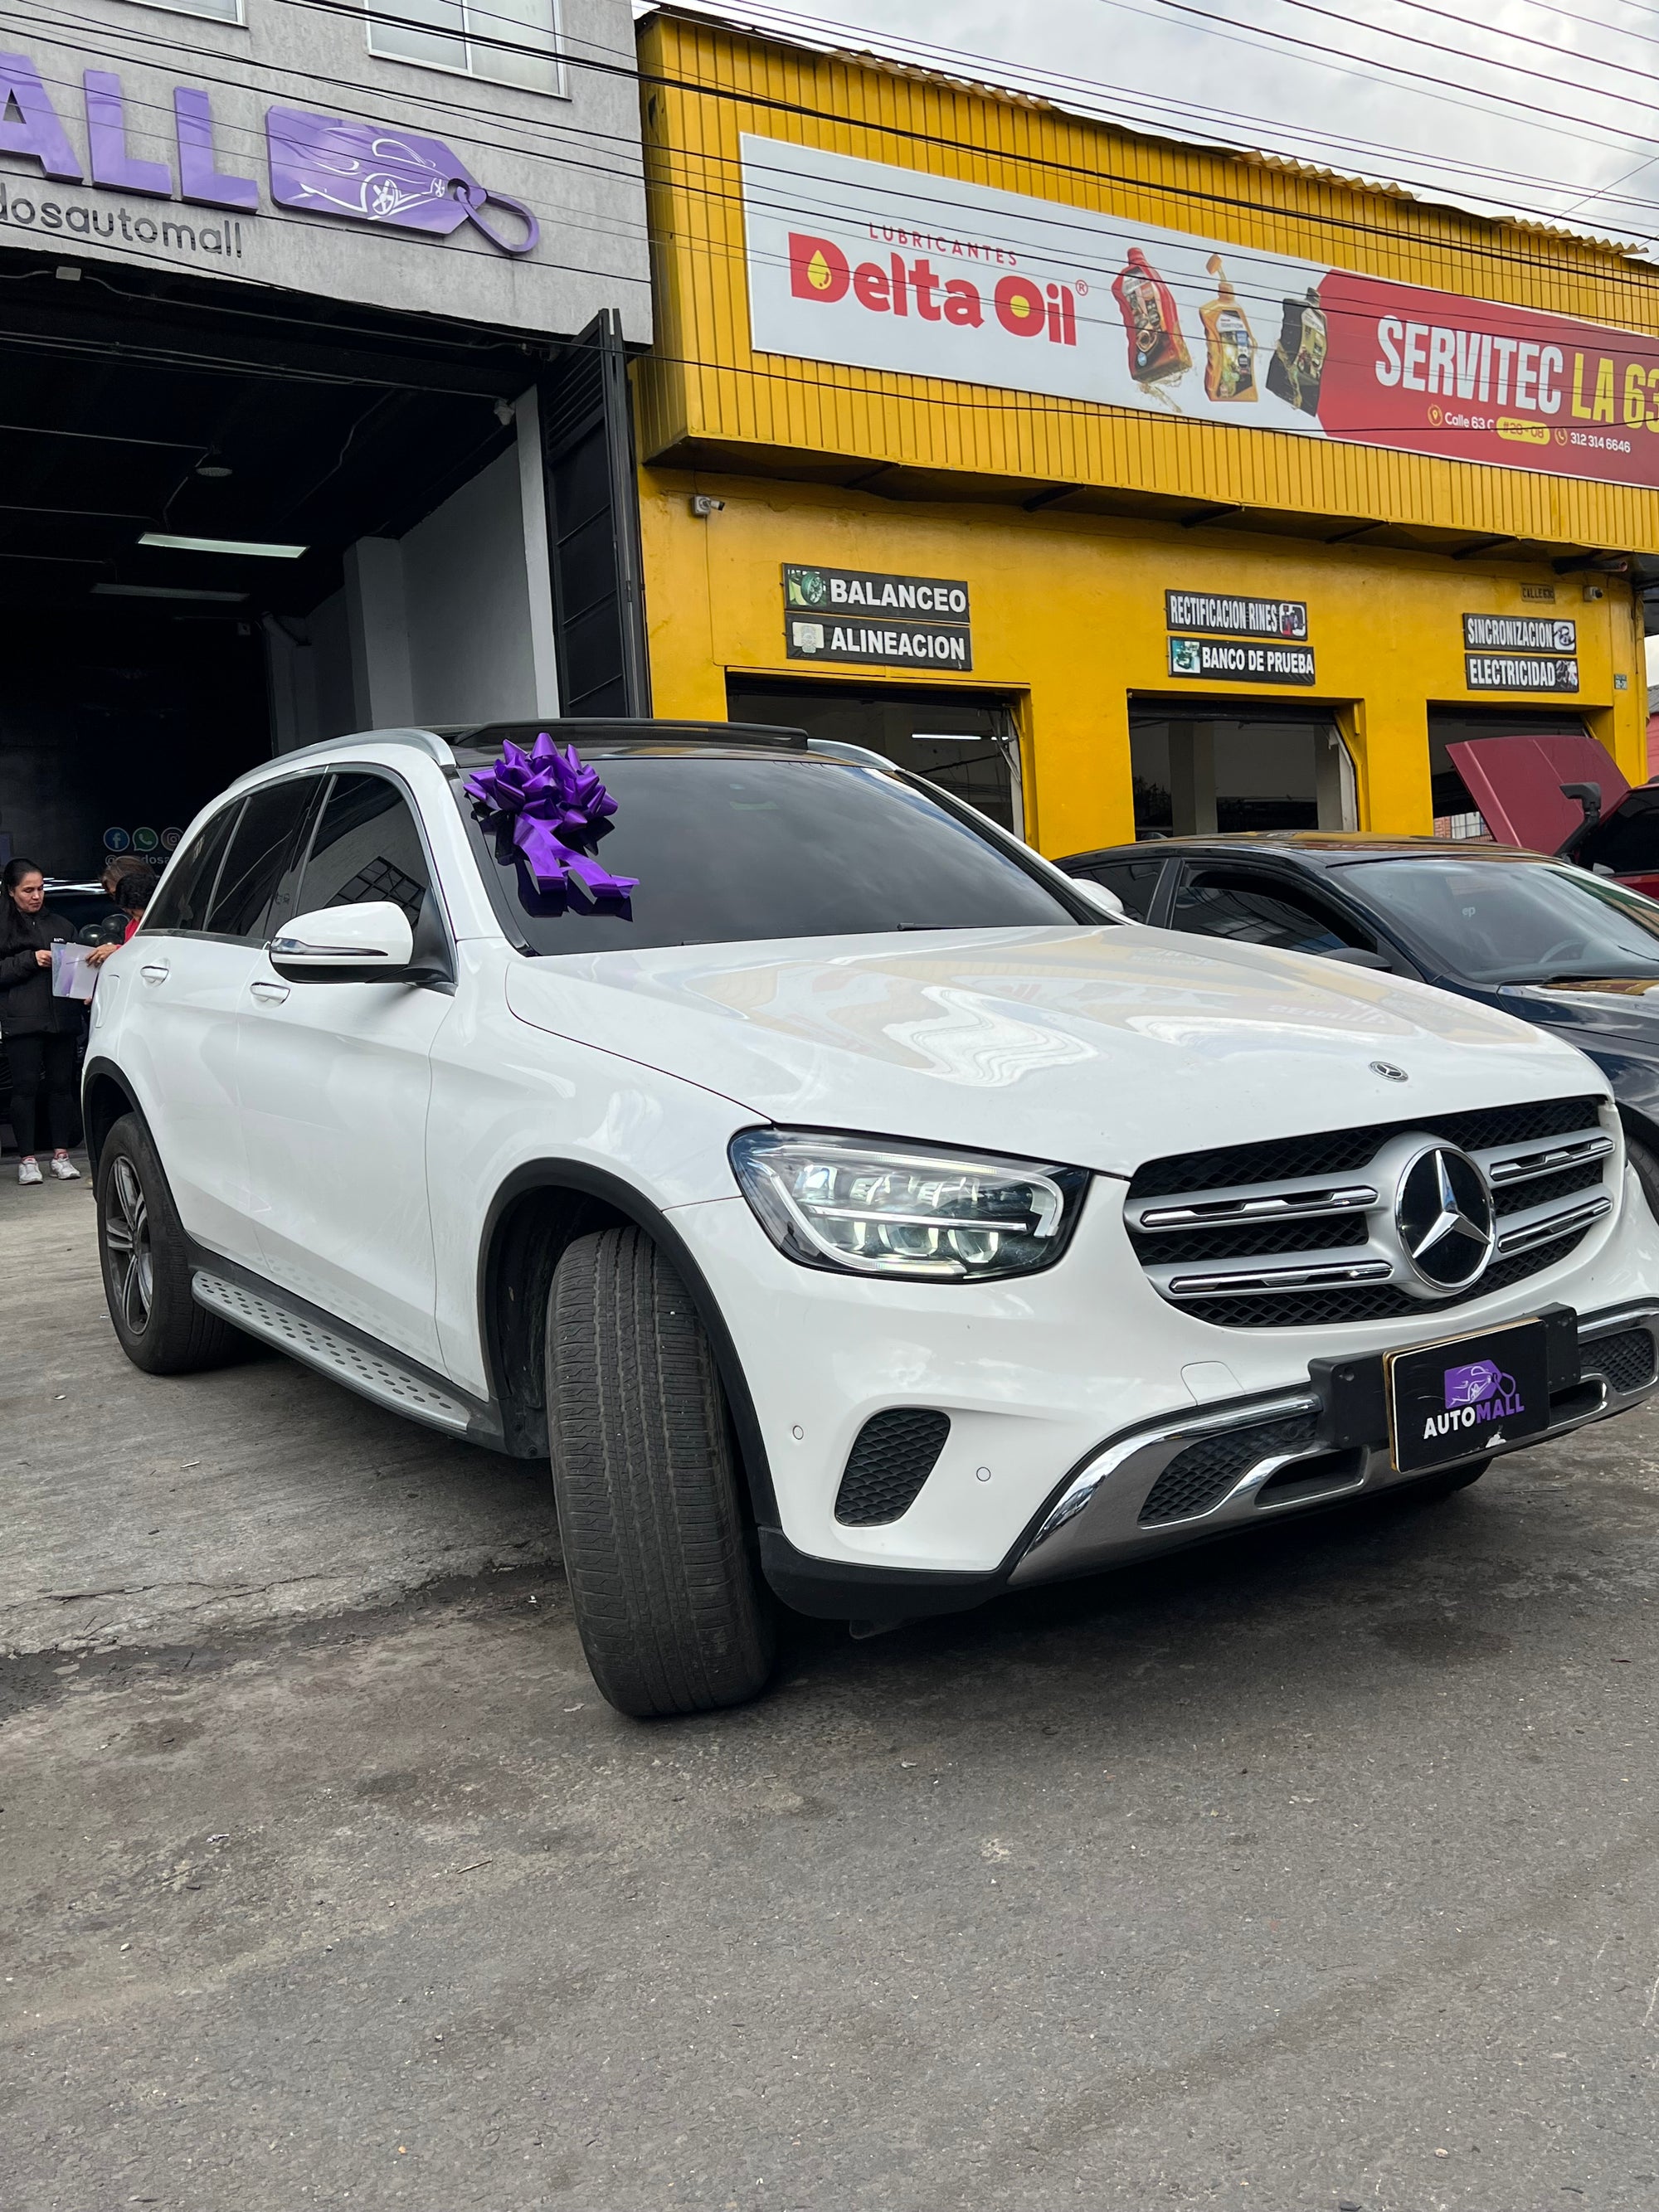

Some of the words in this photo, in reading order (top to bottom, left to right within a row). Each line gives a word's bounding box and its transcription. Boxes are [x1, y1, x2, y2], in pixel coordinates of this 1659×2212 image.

[869, 221, 1017, 266] LUBRICANTES
[788, 231, 985, 328] Delta
[995, 275, 1078, 347] Oil
[1374, 314, 1564, 415] SERVITEC
[1571, 352, 1614, 423] LA
[1444, 411, 1470, 427] Calle
[1471, 416, 1485, 430] 63
[1570, 431, 1587, 446] 312
[1588, 436, 1604, 450] 314
[1605, 437, 1631, 454] 6646
[830, 578, 966, 613] BALANCEO
[1170, 595, 1247, 630] RECTIFICACION
[1248, 602, 1277, 632] RINES
[830, 627, 966, 660] ALINEACION
[1467, 617, 1553, 648] SINCRONIZACION
[1202, 646, 1245, 671] BANCO
[1248, 649, 1265, 672] DE
[1267, 650, 1315, 675] PRUEBA
[1469, 658, 1556, 687] ELECTRICIDAD
[1423, 1393, 1525, 1439] AUTOMALL
